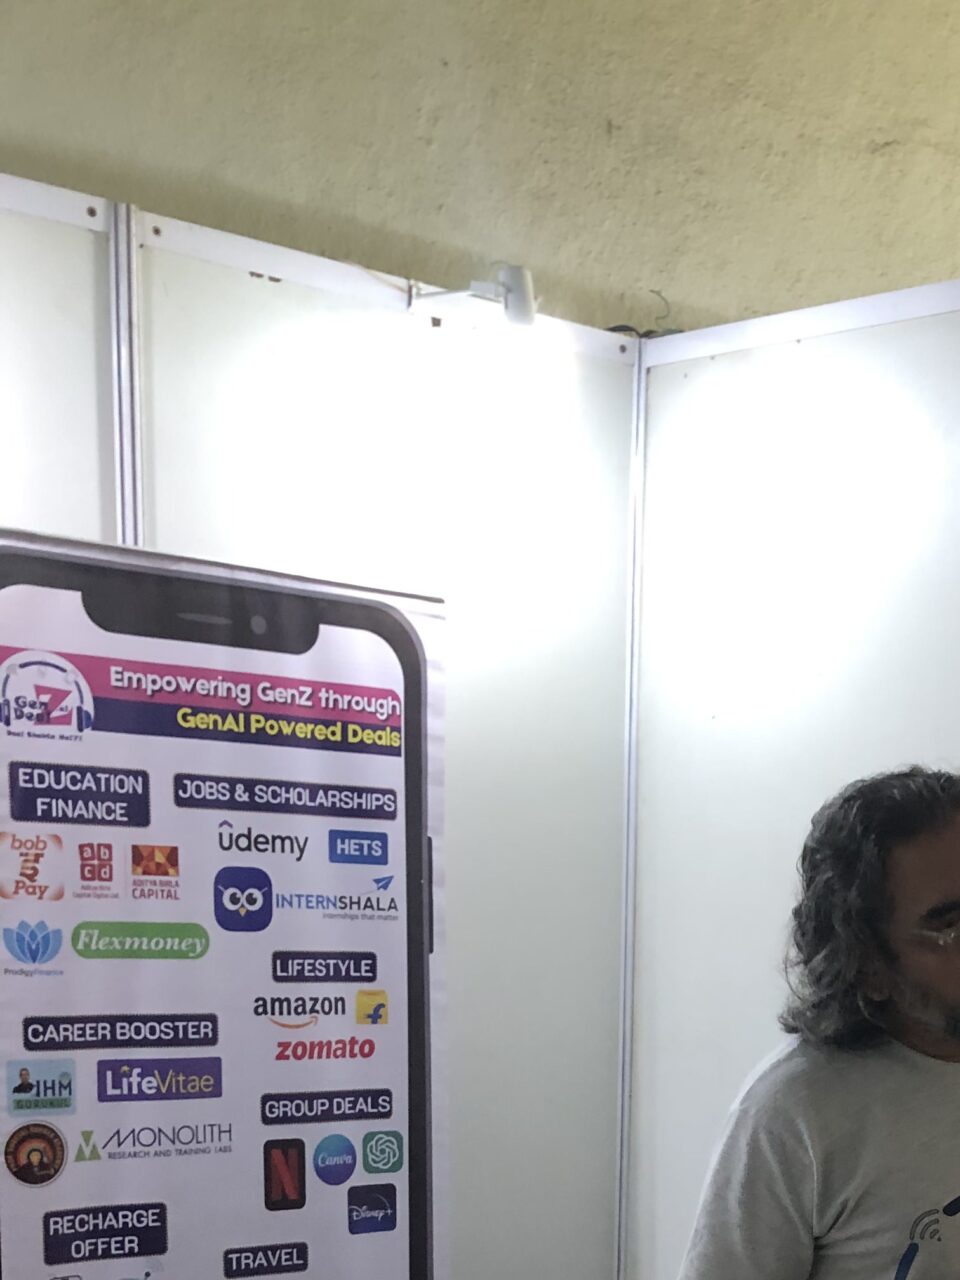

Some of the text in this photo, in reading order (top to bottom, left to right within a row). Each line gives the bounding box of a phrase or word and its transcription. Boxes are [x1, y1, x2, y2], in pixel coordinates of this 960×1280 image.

[110, 667, 401, 720] Empowering GenZ through
[177, 707, 401, 748] GenAI Powered Deals
[19, 768, 142, 794] EDUCATION
[179, 779, 396, 812] JOBS & SCHOLARSHIPS
[37, 798, 128, 821] FINANCE
[11, 834, 47, 851] bob
[336, 838, 382, 857] HETS
[13, 880, 49, 900] Pay
[132, 888, 180, 900] CAPITAL
[275, 893, 399, 912] INTERNSHALA
[76, 929, 206, 957] Flexmoney
[276, 959, 373, 977] LIFESTYLE
[253, 996, 346, 1016] amazon
[27, 1021, 213, 1043] CAREER BOOSTER
[275, 1036, 376, 1061] zomato
[106, 1065, 214, 1095] LifeVitae
[265, 1096, 390, 1118] GROUP DEALS
[102, 1123, 232, 1149] MONOLITH
[108, 1150, 150, 1159] RESEARCH
[153, 1149, 172, 1157] AND
[318, 1154, 352, 1168] Canva
[50, 1209, 161, 1235] RECHARGE
[71, 1236, 138, 1258] OFFER
[228, 1248, 304, 1270] TRAVEL
